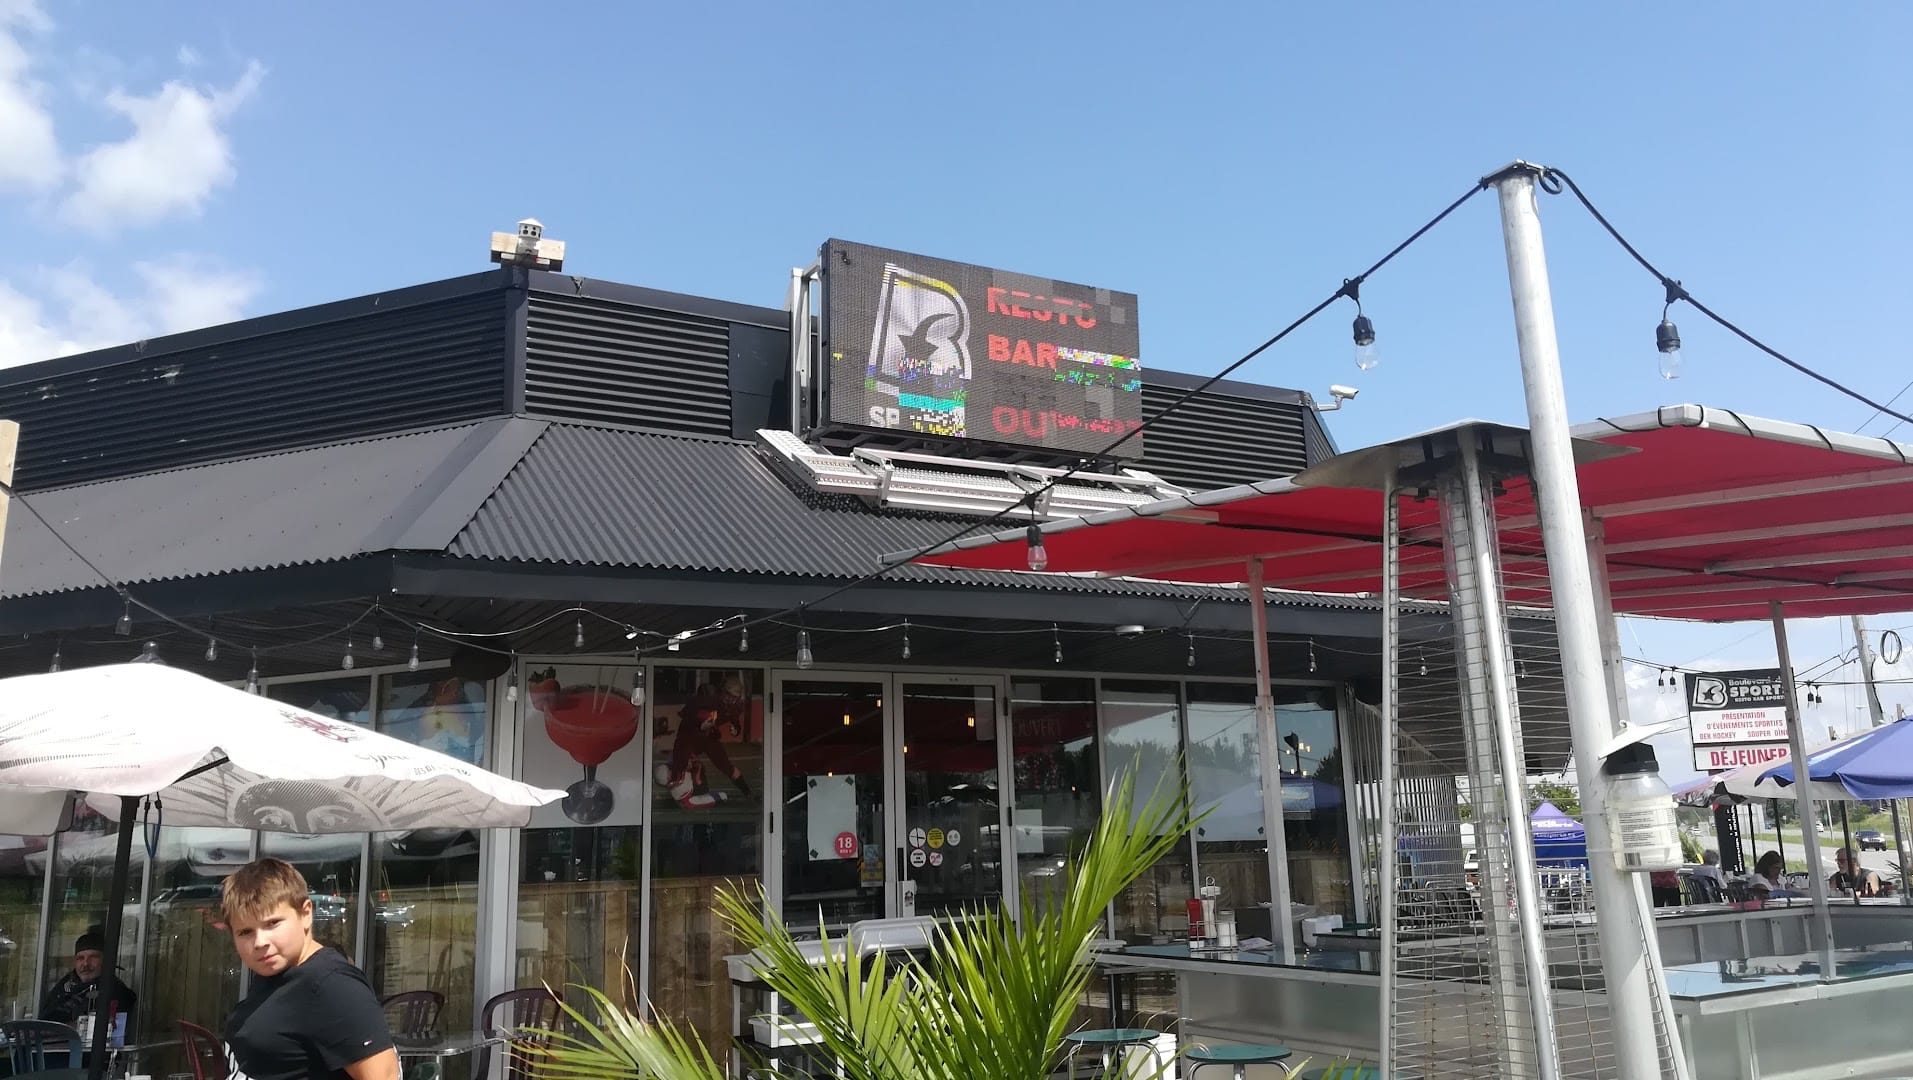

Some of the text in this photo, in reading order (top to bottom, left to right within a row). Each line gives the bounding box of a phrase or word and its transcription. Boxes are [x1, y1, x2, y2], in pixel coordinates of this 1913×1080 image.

[988, 334, 1057, 369] BAR
[1729, 684, 1785, 697] SPORT
[1722, 711, 1766, 720] PRÉSENTATION
[1755, 719, 1783, 728] SPORTIFS
[1713, 731, 1736, 739] HOCKEY
[1747, 730, 1771, 738] SOUPER
[838, 837, 852, 850] 18
